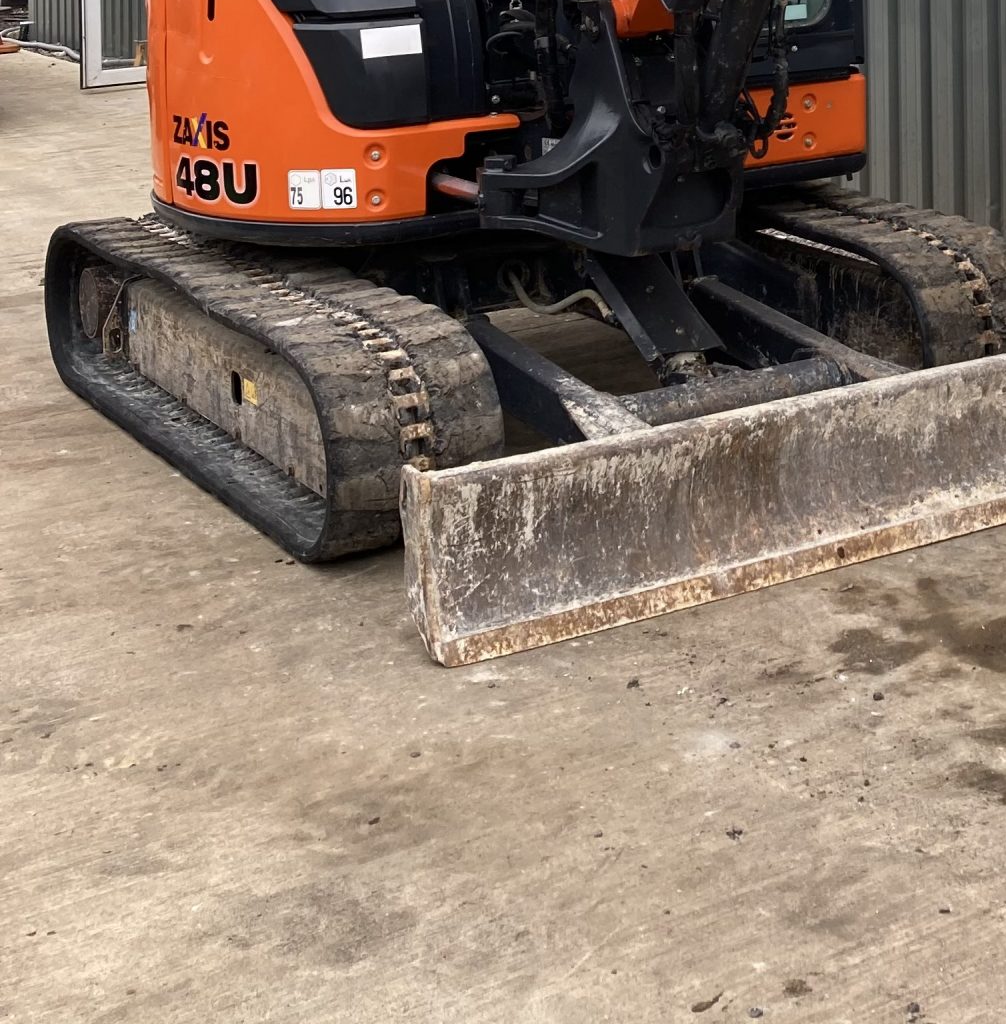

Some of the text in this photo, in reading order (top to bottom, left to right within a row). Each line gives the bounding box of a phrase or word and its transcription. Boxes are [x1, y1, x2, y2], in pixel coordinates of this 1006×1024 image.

[173, 112, 230, 151] ZAXIS
[176, 156, 258, 205] 48U
[290, 186, 304, 206] 75
[333, 186, 353, 206] 96
